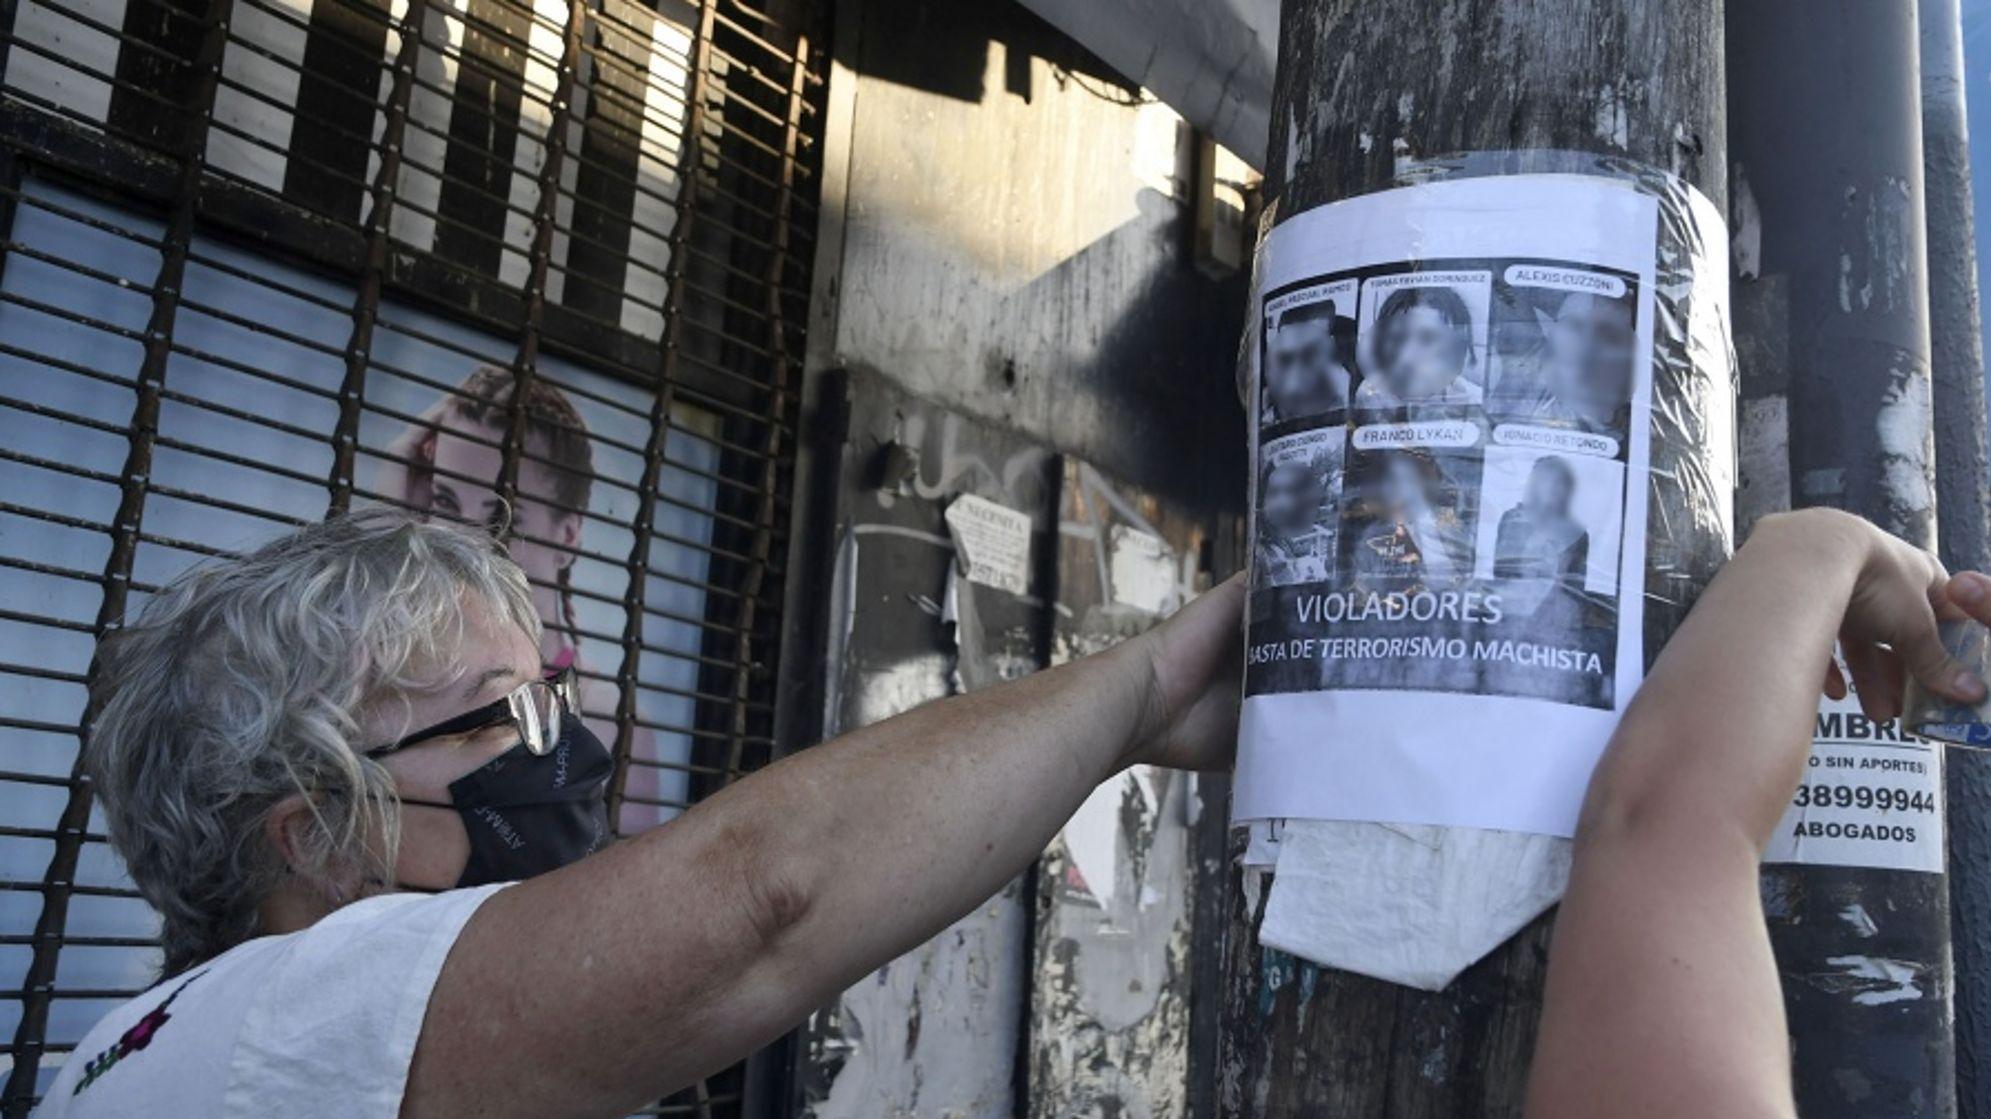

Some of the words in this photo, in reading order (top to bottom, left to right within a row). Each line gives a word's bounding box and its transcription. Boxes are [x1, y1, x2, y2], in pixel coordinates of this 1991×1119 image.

[1515, 270, 1560, 283] ALEXIS
[1562, 274, 1615, 292] CUZZONI
[1363, 428, 1414, 443] FRANCO
[1417, 427, 1463, 442] LYKAN
[1504, 429, 1551, 443] IGNACIO
[1553, 435, 1608, 452] RETONDO
[1297, 591, 1503, 624] VIOLADORES
[1290, 639, 1315, 659] DE
[1319, 636, 1467, 660] TERRORISMO
[1472, 639, 1603, 675] MACHISTA
[1825, 757, 1855, 769] SIN
[1792, 821, 1917, 843] ABOGADOS
